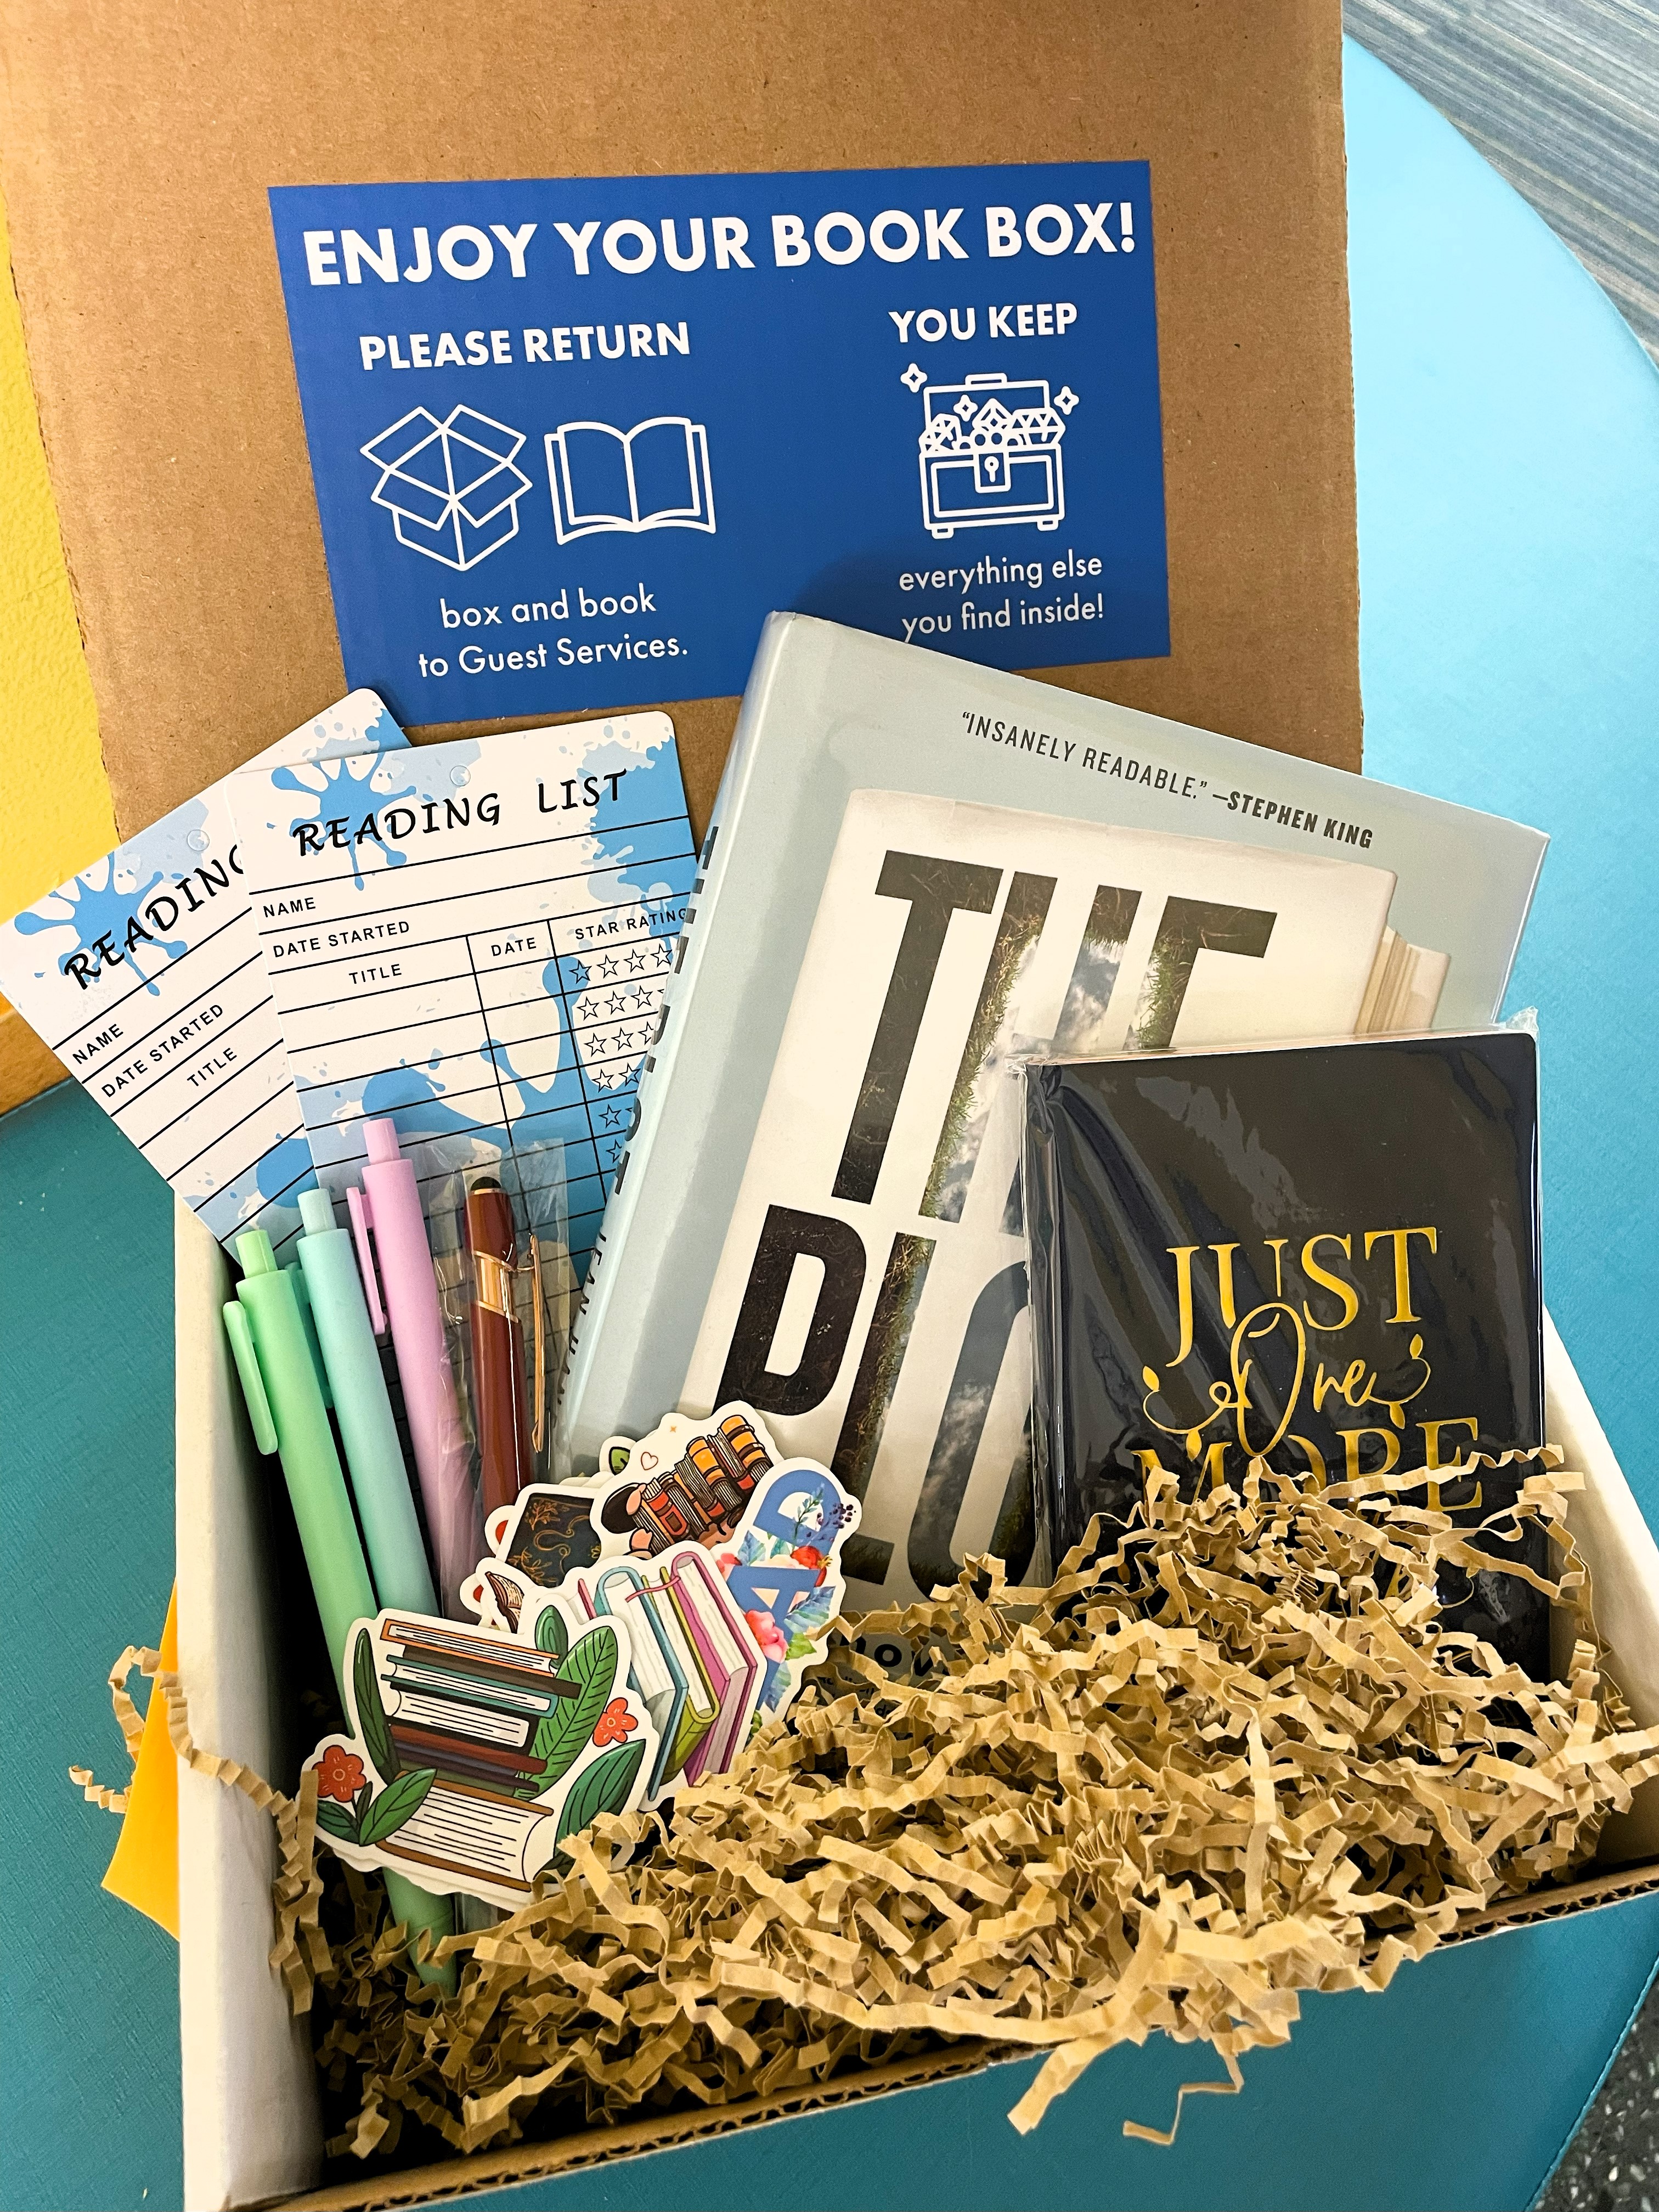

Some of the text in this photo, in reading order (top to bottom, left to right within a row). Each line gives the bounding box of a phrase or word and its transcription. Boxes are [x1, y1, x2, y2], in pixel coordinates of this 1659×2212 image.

[303, 202, 1134, 285] ENJOY YOUR BOOK BOX!
[889, 303, 1077, 342] YOU KEEP
[359, 322, 690, 370] PLEASE RETURN
[900, 548, 1102, 594] everything else
[441, 583, 656, 628] box and book
[901, 593, 1103, 644] you find inside!
[419, 634, 687, 677] to Guest Services.
[292, 769, 627, 856] READING LIST
[1324, 819, 1372, 848] KING
[263, 898, 315, 917] NAME
[575, 909, 686, 939] STAR RATING
[274, 922, 409, 957] DATE STARTED
[492, 938, 536, 956] DATE
[349, 964, 401, 984] TITLE
[73, 1024, 123, 1064] NAME
[101, 1005, 222, 1097] DATE STARTED
[187, 1048, 236, 1086] TITLE
[1165, 1227, 1437, 1367] JUST
[1193, 1303, 1407, 1457] One
